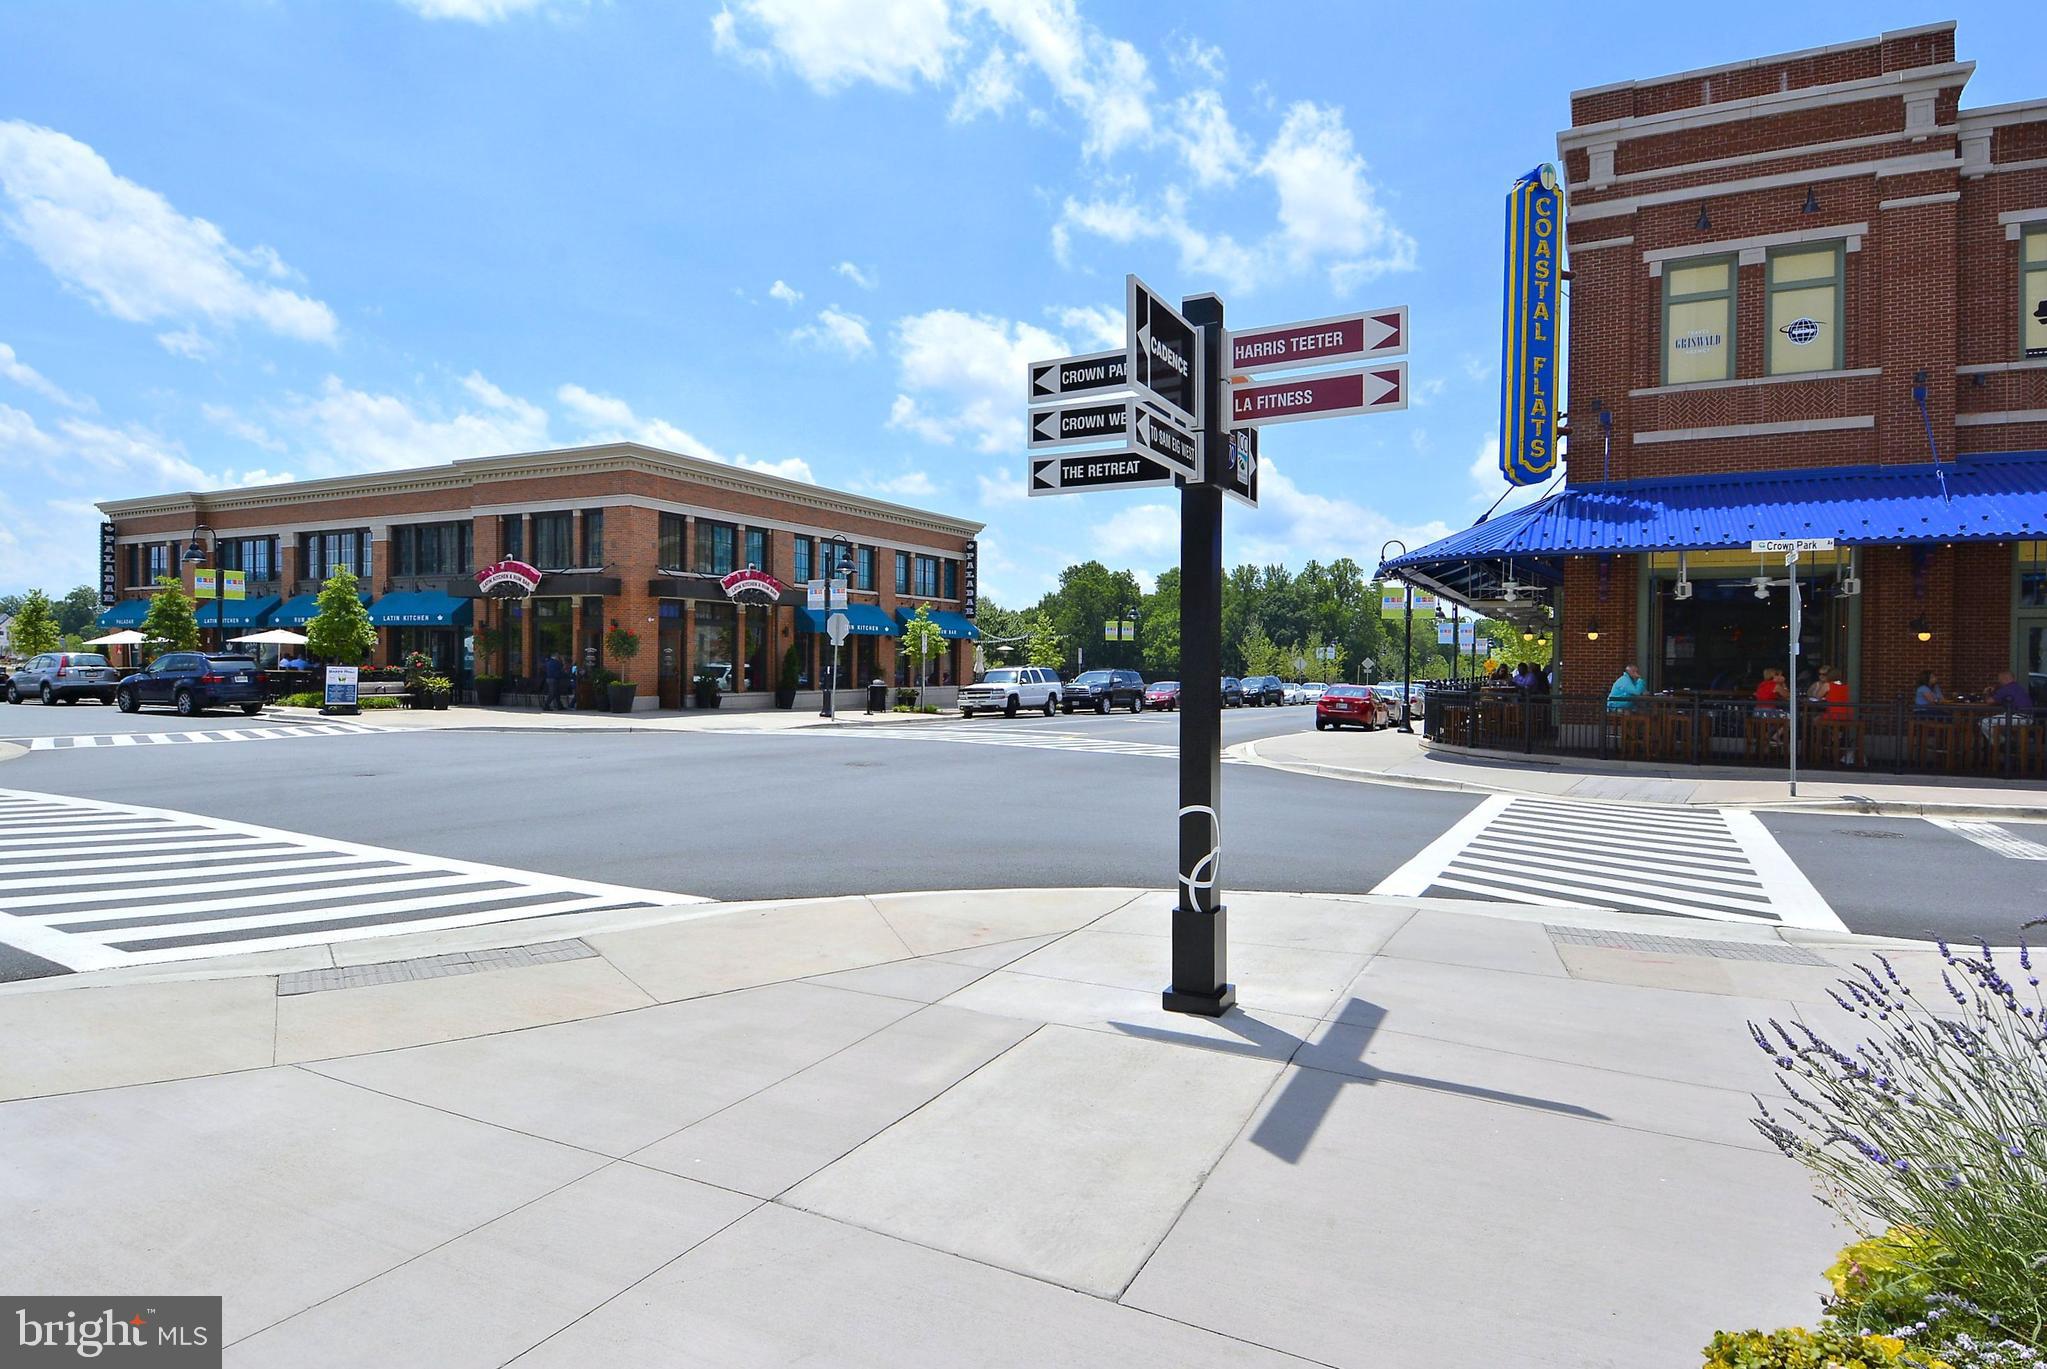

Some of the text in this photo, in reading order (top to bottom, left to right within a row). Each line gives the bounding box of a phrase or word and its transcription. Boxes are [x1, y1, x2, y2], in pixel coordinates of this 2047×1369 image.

[1530, 197, 1551, 458] COASTAL FLATS
[1235, 331, 1343, 360] HARRIS TEETER
[1675, 334, 1721, 349] GRISWALD
[1151, 336, 1188, 377] CADENCE
[1062, 366, 1104, 385] CROWN
[1235, 389, 1313, 413] LA FITNESS
[1062, 414, 1104, 431] CROWN
[1150, 425, 1195, 461] TO SAM EIG WEST
[1062, 460, 1140, 479] THE RETREAT
[1766, 541, 1795, 551] Crown
[1797, 540, 1818, 550] Park
[104, 535, 115, 602] PALADAR
[965, 552, 975, 615] PALADAR
[402, 614, 429, 622] KITCHEN
